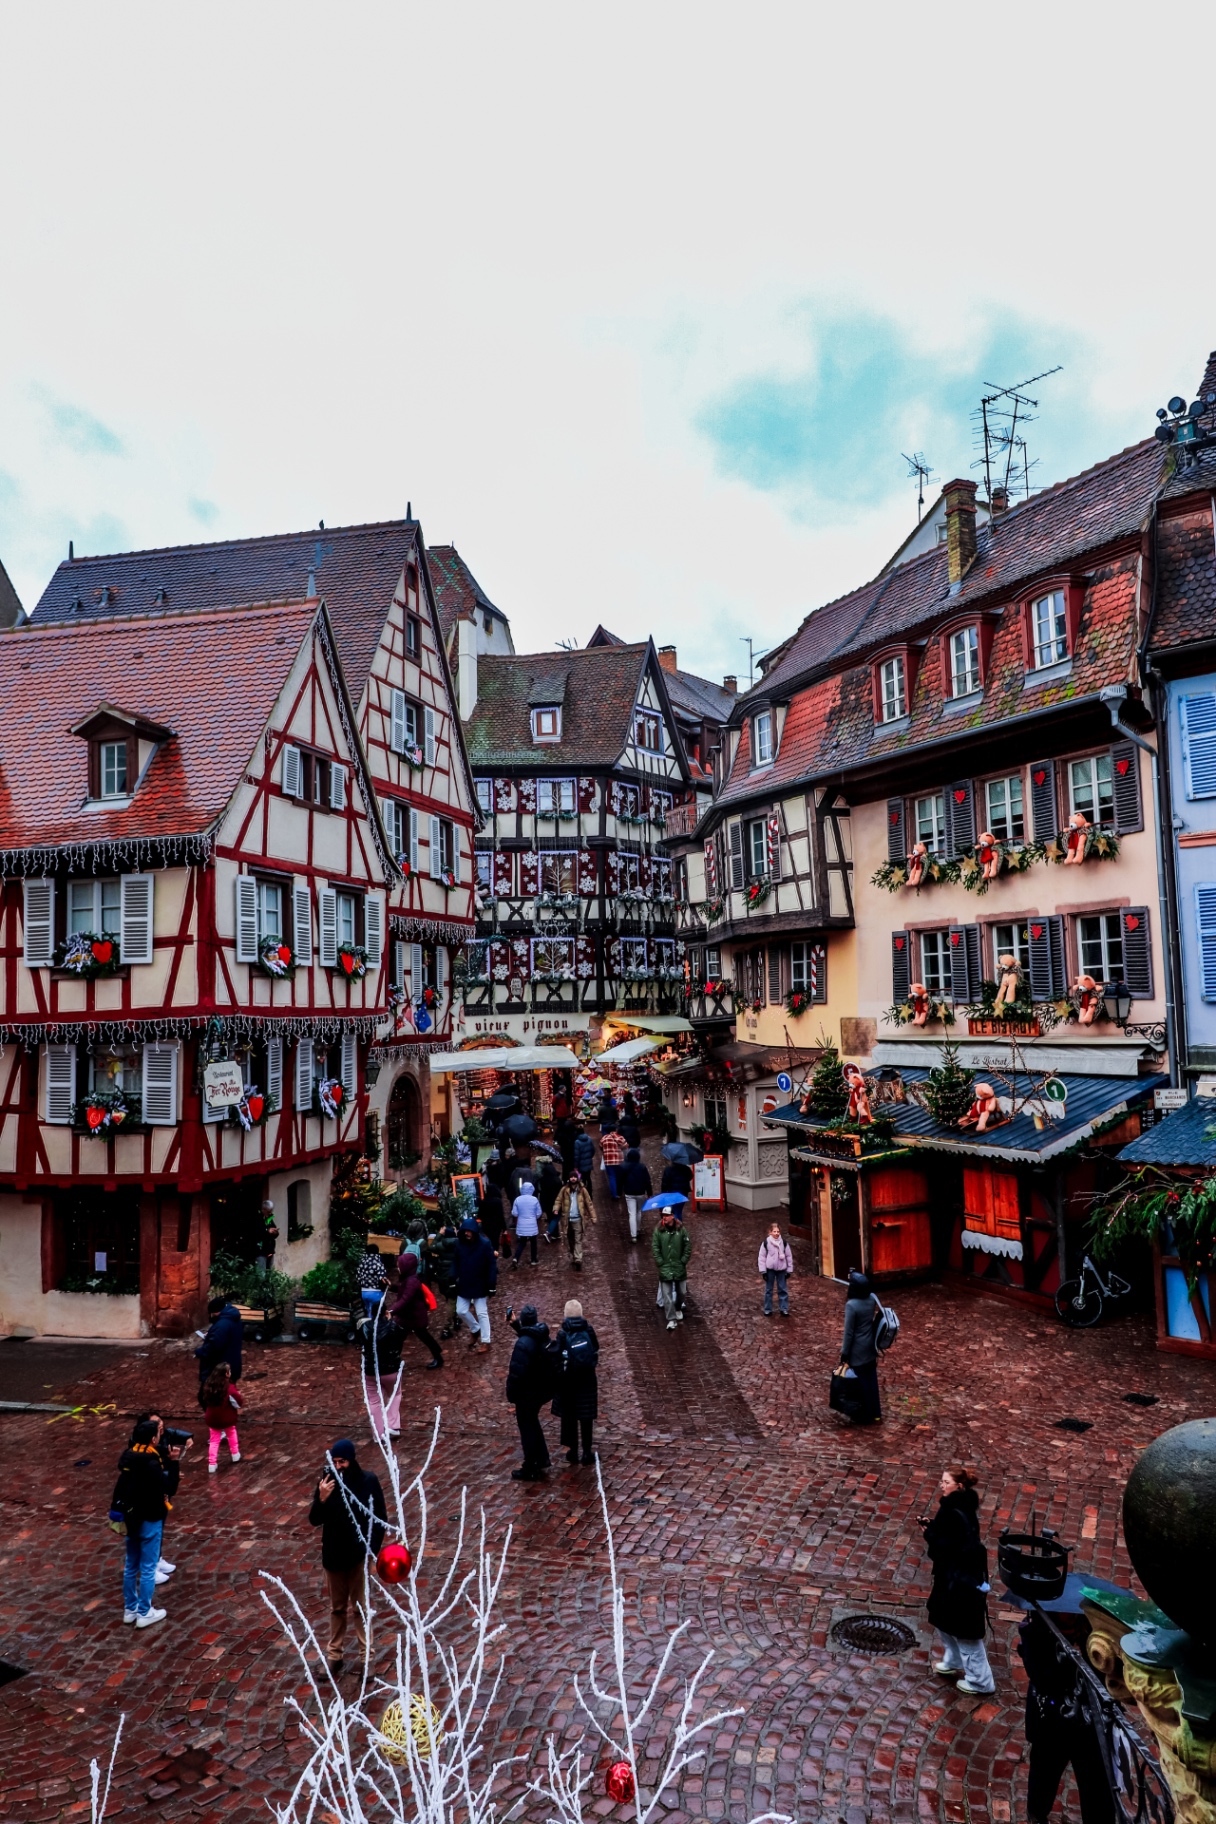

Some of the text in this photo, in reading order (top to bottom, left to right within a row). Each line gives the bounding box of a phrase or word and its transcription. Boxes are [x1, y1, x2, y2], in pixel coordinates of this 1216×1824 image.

[523, 1016, 569, 1033] pignon
[975, 1021, 988, 1034] LE
[971, 1055, 1008, 1066] Le Bistrot
[780, 1077, 786, 1089] 7
[1050, 1085, 1059, 1098] 1
